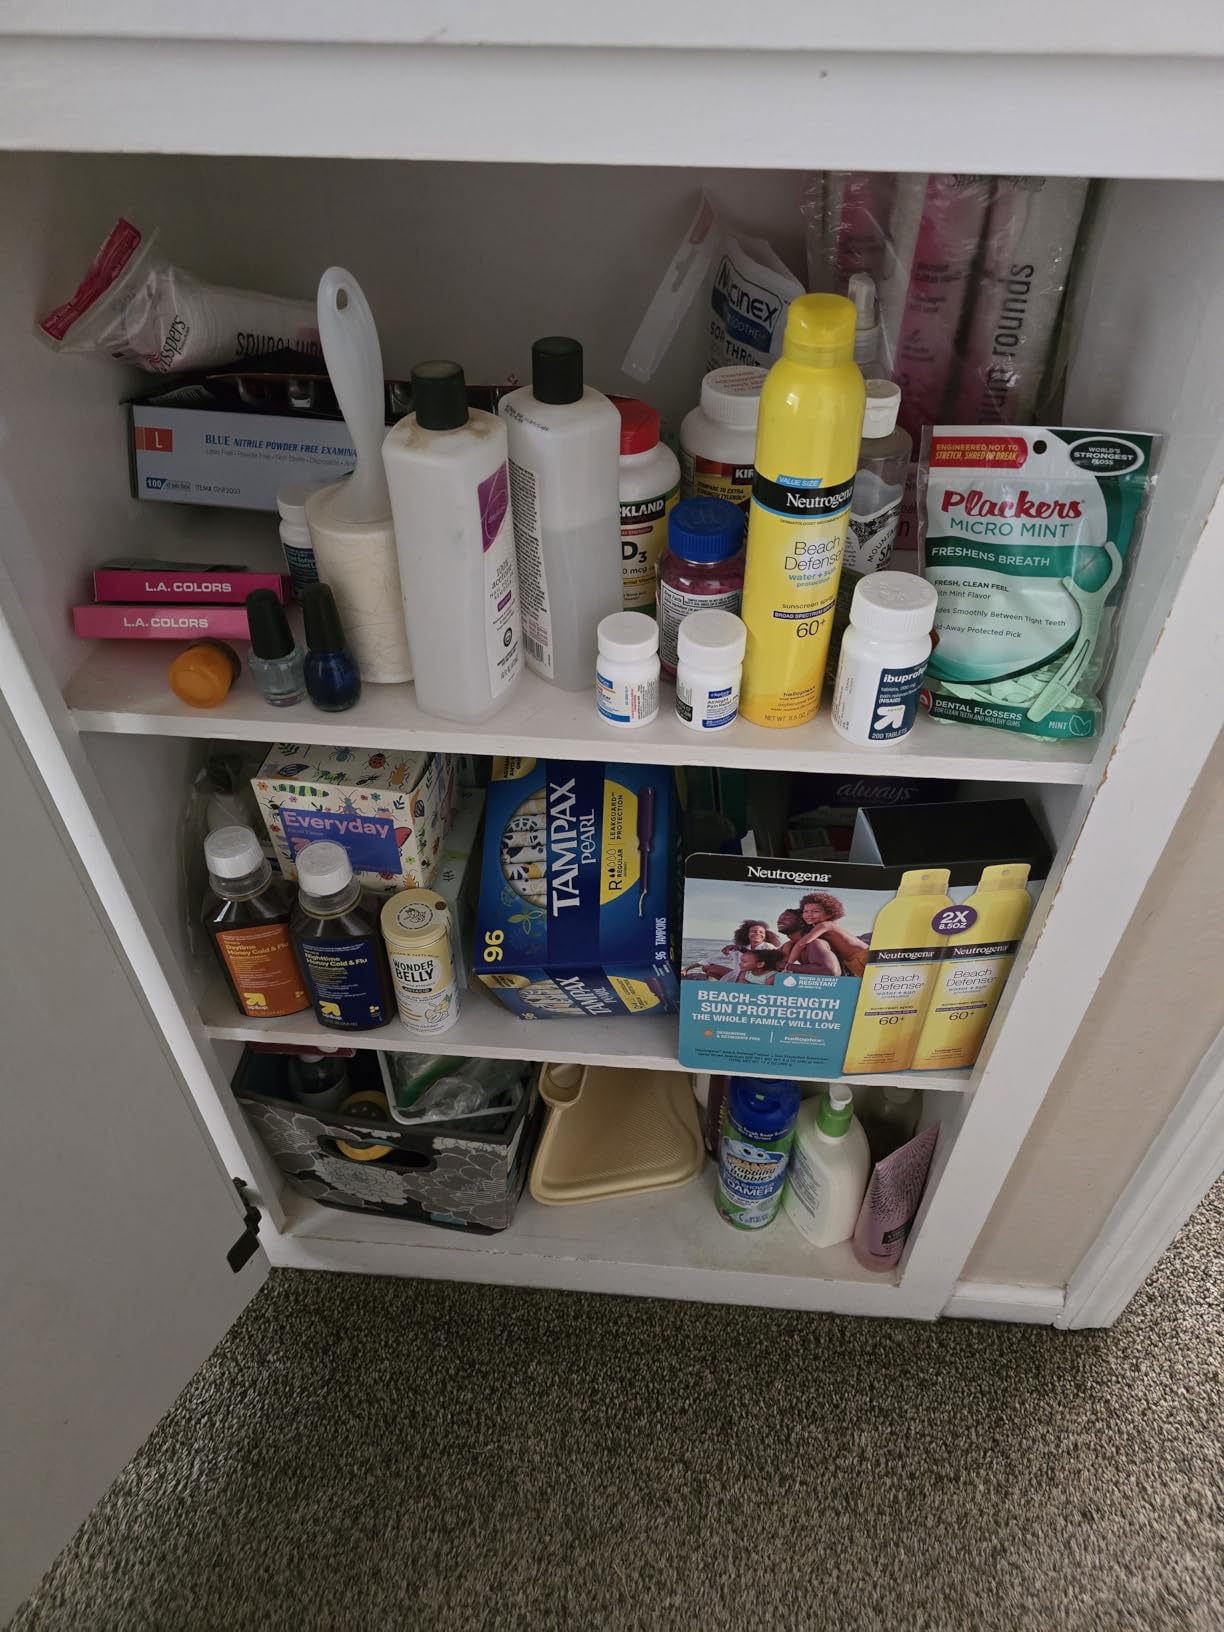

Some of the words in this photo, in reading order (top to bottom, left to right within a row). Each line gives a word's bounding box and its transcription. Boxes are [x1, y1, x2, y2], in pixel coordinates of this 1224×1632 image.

[155, 431, 163, 449] L
[205, 434, 231, 447] BLUE
[233, 438, 264, 449] NITRILE
[265, 441, 298, 452] POWDER
[300, 443, 319, 454] FREE
[965, 452, 986, 460] SHRED
[995, 452, 1018, 461] BREAK
[1073, 452, 1134, 461] STRONGEST
[1091, 458, 1114, 466] FLOSS
[147, 480, 162, 489] 100
[779, 476, 799, 485] VALUE
[801, 478, 819, 487] SIZE
[941, 489, 1083, 519] Plackers
[950, 517, 1013, 537] MICRO
[1020, 522, 1070, 538] MINT
[794, 536, 840, 556] Beach
[784, 547, 841, 571] Defense
[931, 547, 995, 561] FRESHENS
[999, 555, 1050, 567] BREATH
[145, 582, 171, 592] L.A.
[173, 582, 232, 592] COLORS
[934, 579, 961, 587] FRESH,
[962, 580, 989, 589] CLEAN
[991, 583, 1009, 592] FEEL
[967, 591, 991, 599] Flavor
[952, 607, 989, 617] Smoothly
[990, 611, 1023, 621] Between
[1025, 615, 1043, 625] Tight
[123, 617, 149, 628] L.A.
[150, 617, 209, 629] COLORS
[967, 626, 1004, 636] Protected
[1005, 630, 1022, 638] Pick
[935, 700, 971, 712] DENTAL
[974, 706, 1022, 720] FLOSSERS
[1049, 721, 1068, 729] MINT
[836, 780, 912, 801] always
[283, 811, 389, 839] Everyday
[550, 777, 581, 917] TAMPAX
[747, 866, 829, 883] Neutrogena
[608, 880, 622, 890] R
[941, 911, 969, 924] 2X
[655, 917, 667, 946] TAMPONS
[483, 929, 505, 962] 96
[655, 950, 666, 961] 96
[878, 950, 935, 960] Neutrogena
[306, 958, 330, 968] Honey
[355, 957, 368, 965] Flu
[393, 960, 434, 973] WONDER
[395, 968, 434, 982] BELLY
[881, 974, 920, 983] Beach
[953, 968, 993, 979] Beach
[798, 980, 838, 988] RESISTANT
[698, 990, 840, 1010] BEACH-STRENGTH
[701, 1002, 733, 1014] SUN
[737, 1005, 834, 1021] PROTECTION
[692, 1013, 711, 1021] THE
[713, 1015, 748, 1025] WHOLE
[750, 1017, 786, 1027] FAMILY
[788, 1020, 812, 1029] WILL
[815, 1022, 840, 1031] LOVE
